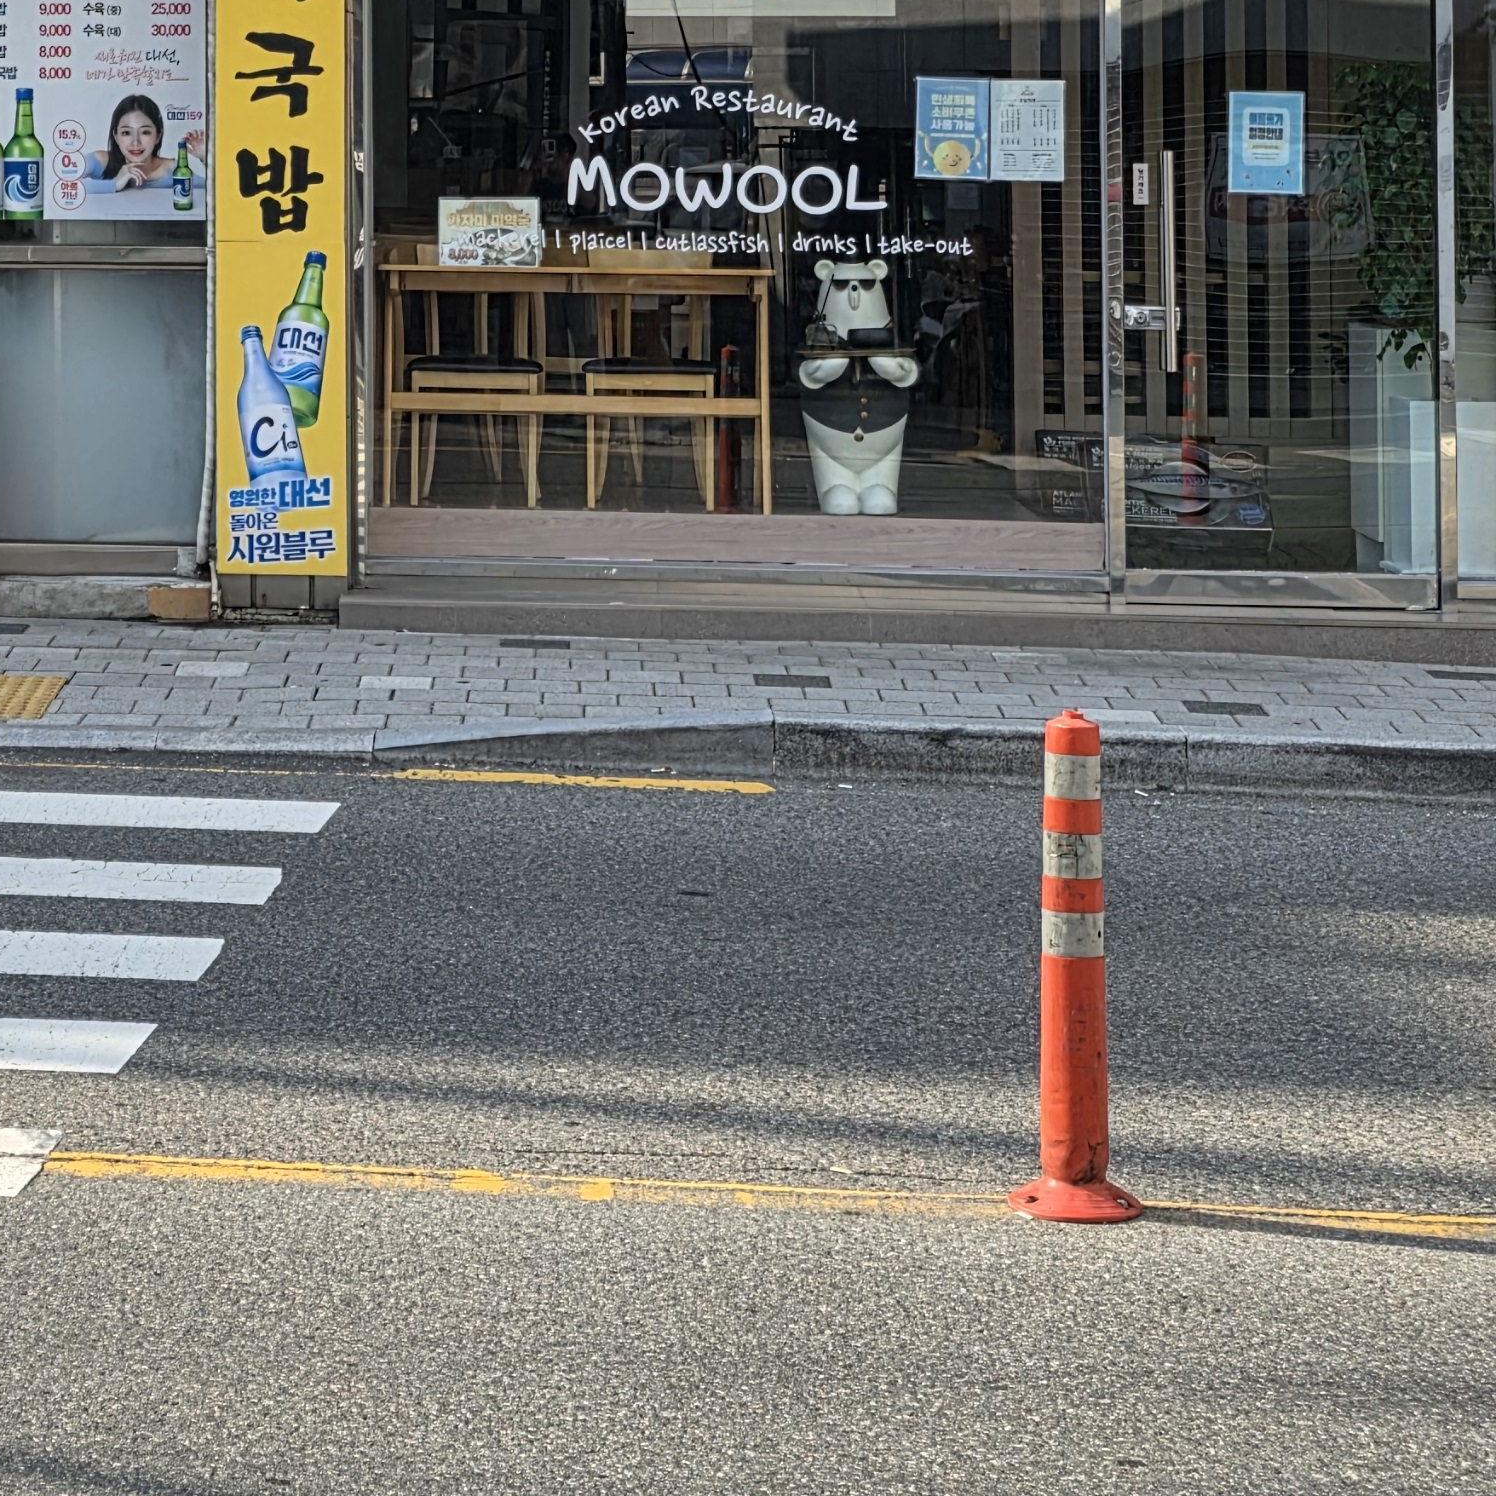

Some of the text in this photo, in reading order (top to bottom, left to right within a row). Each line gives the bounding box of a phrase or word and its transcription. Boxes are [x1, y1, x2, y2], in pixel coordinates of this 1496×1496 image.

[39, 3, 72, 16] 9,000
[83, 2, 105, 16] 수육
[151, 2, 192, 16] 25,000
[39, 24, 72, 38] 9,000
[83, 23, 122, 37] 수육 (대)
[151, 24, 192, 37] 30,000
[39, 45, 72, 59] 8,000
[39, 66, 72, 81] 8,000
[696, 86, 859, 142] Restaurant
[567, 154, 888, 215] MOWOOL
[456, 228, 546, 251] mackerel
[655, 234, 769, 254] cutlassfish
[792, 235, 857, 255] drinks
[877, 235, 974, 256] take-out
[277, 327, 324, 356] 대선
[228, 477, 331, 509] 영원한 대선
[229, 512, 279, 532] 돌아온
[227, 530, 336, 564] 시원블루
